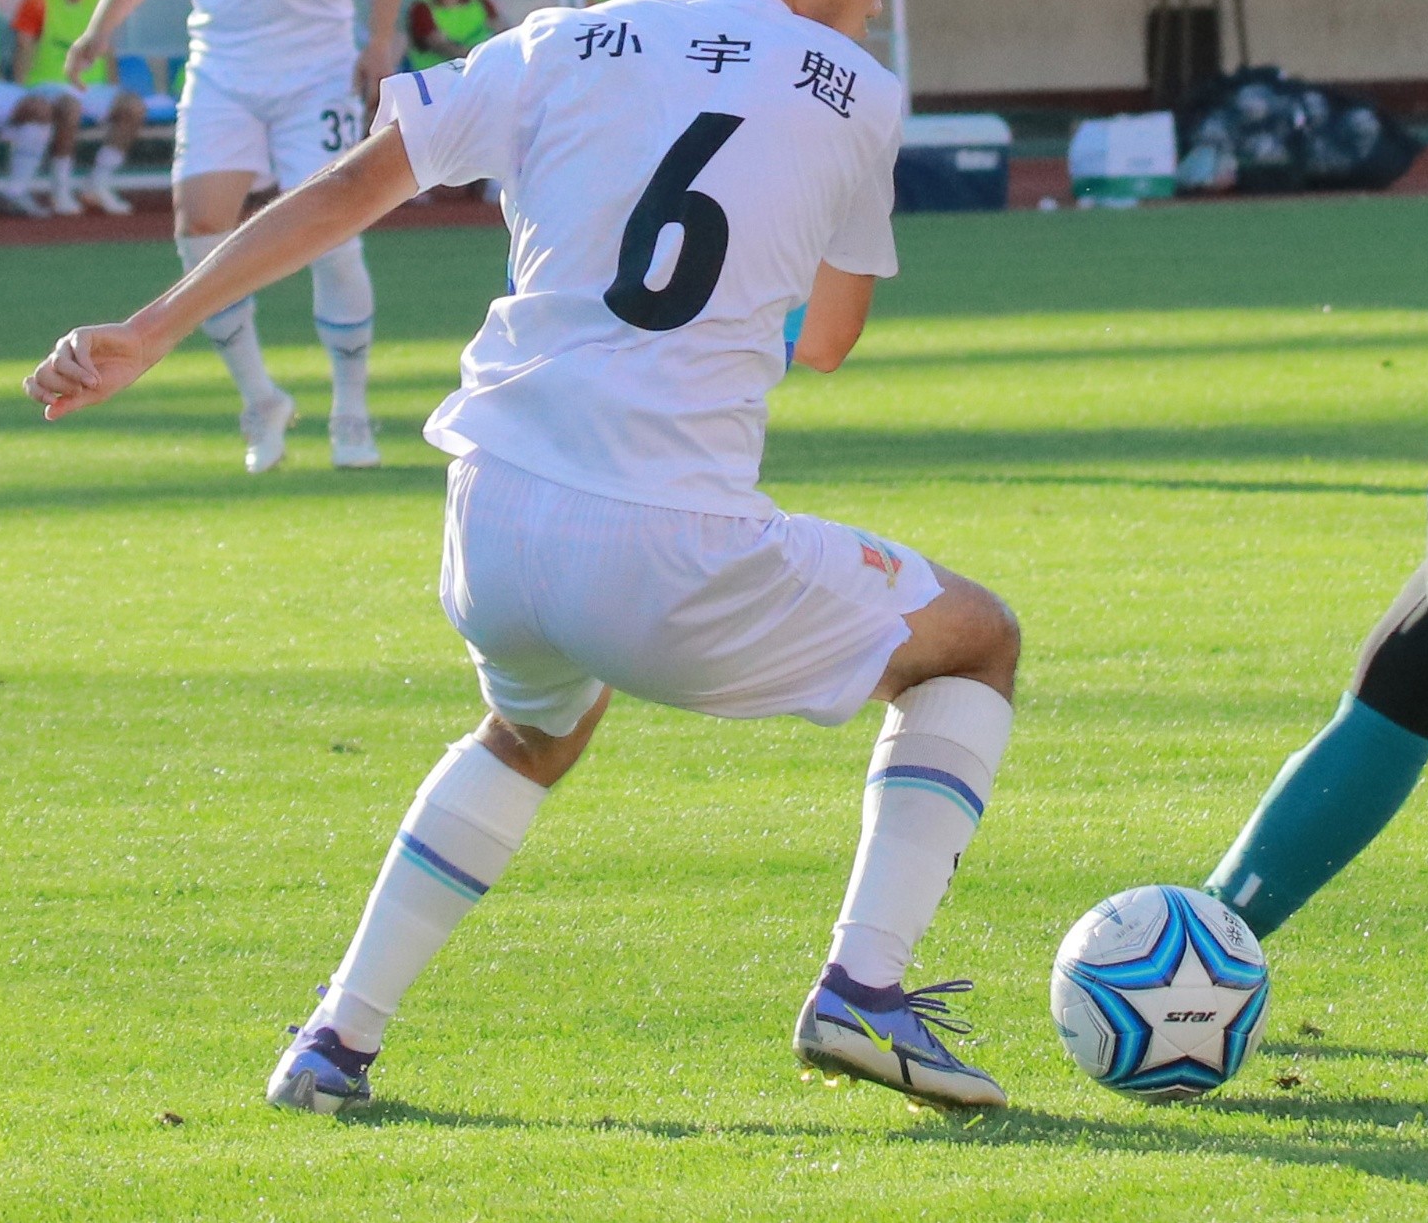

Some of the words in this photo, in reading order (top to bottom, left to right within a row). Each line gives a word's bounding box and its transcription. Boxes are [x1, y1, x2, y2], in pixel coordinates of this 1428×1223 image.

[574, 21, 857, 120] 孙宇魁
[603, 111, 746, 332] 6
